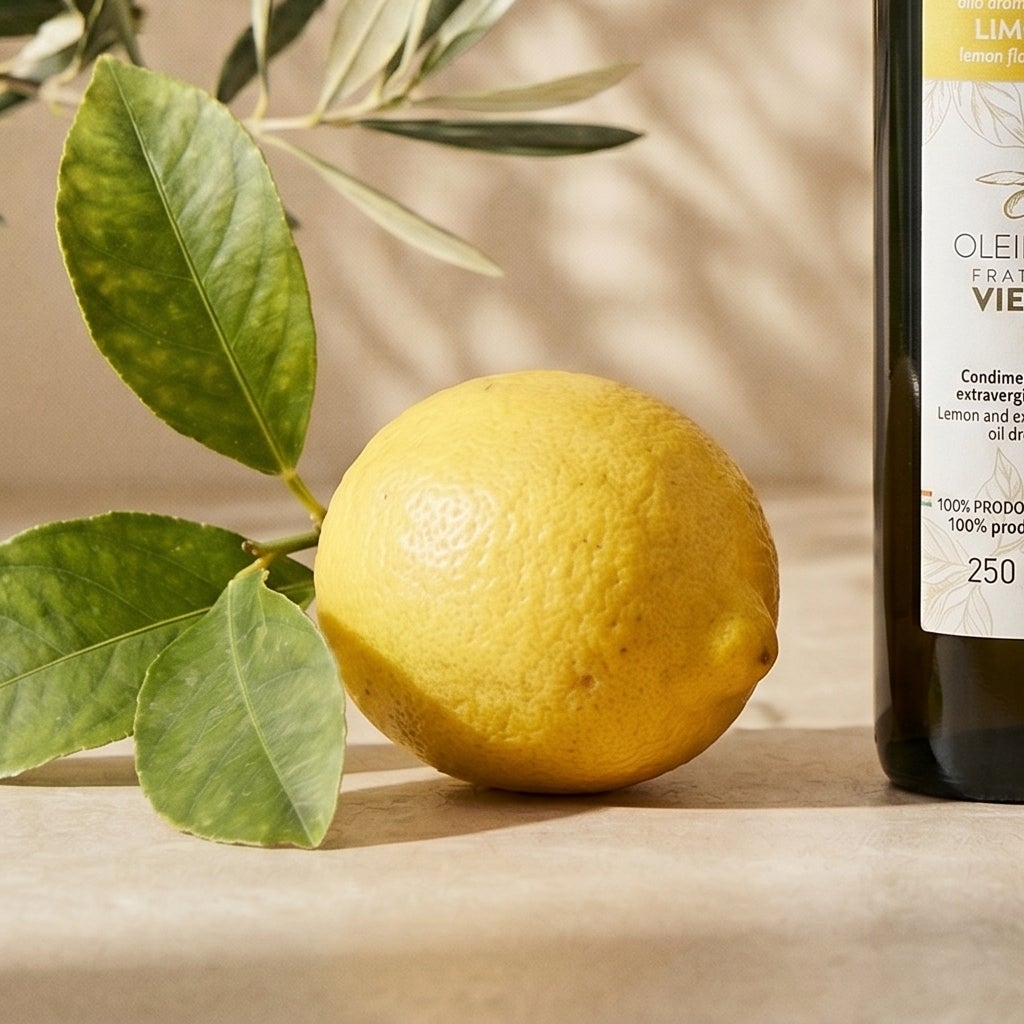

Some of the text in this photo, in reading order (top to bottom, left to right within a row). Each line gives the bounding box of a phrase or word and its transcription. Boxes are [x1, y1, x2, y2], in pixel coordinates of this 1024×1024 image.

[959, 48, 1003, 63] lemon
[938, 406, 980, 422] Lemon
[983, 409, 1008, 423] and
[988, 427, 1005, 441] oil
[937, 498, 970, 513] 100%
[948, 517, 987, 533] 100%
[968, 557, 1015, 584] 250
